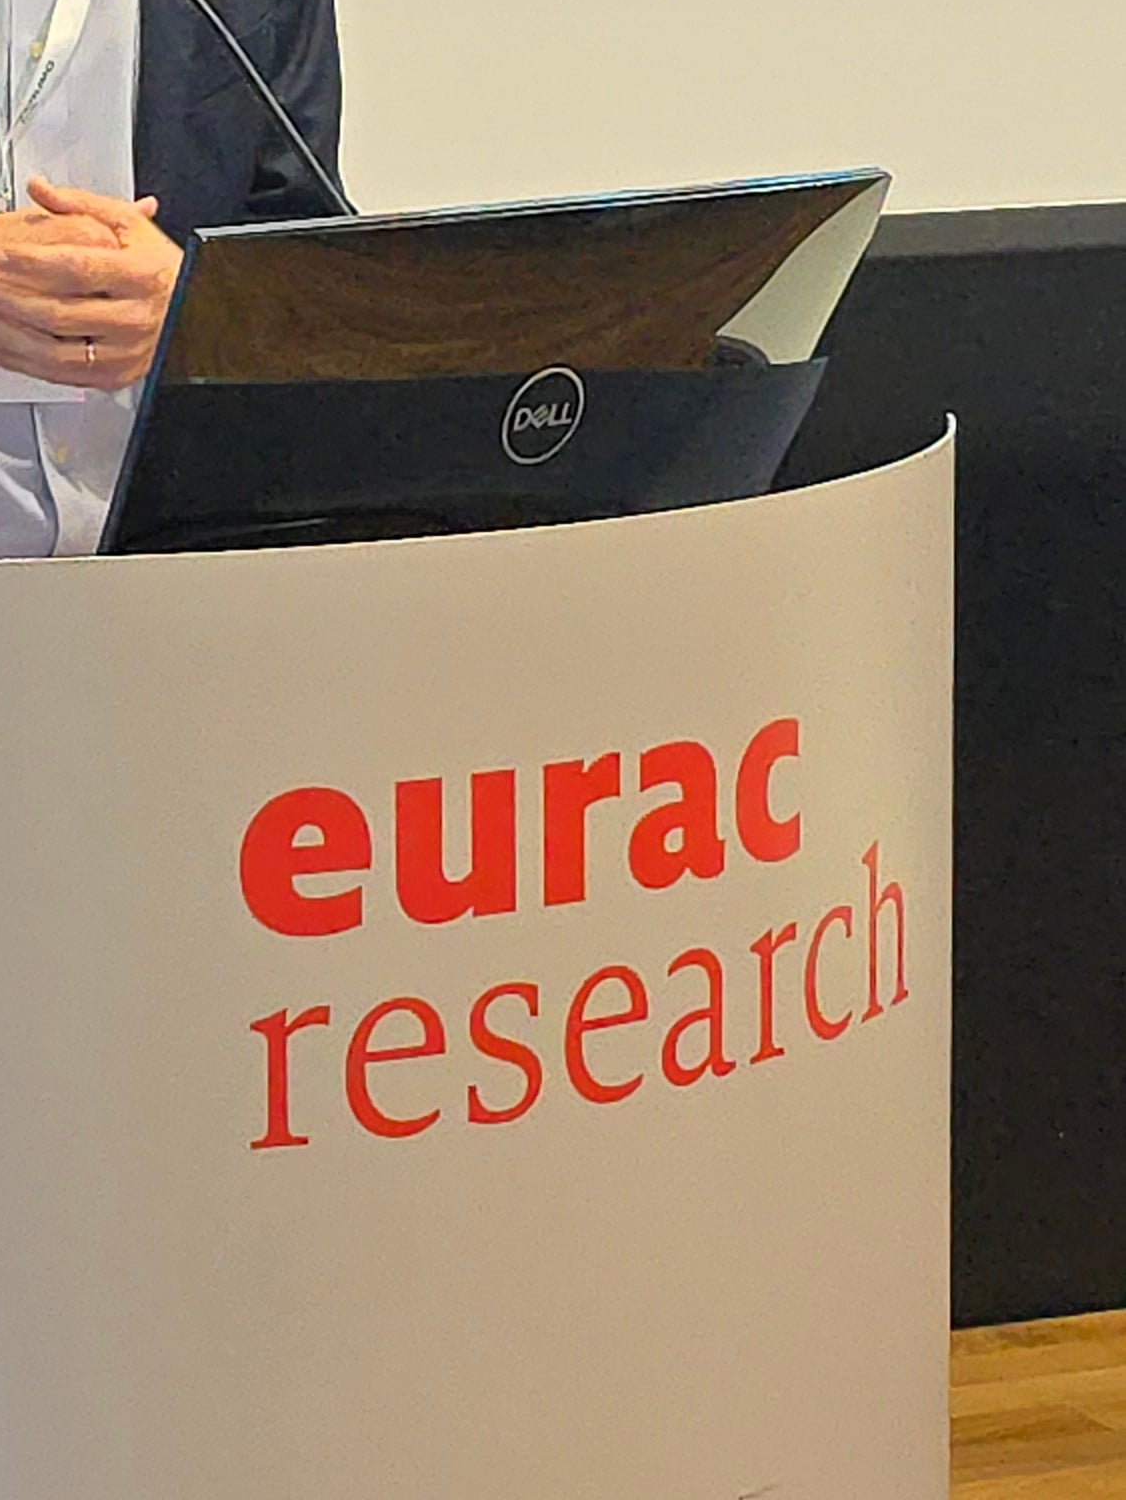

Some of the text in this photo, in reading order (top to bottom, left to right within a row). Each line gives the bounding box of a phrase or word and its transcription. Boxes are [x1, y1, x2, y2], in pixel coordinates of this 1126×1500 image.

[513, 402, 573, 431] DELL
[239, 718, 800, 937] eurac
[250, 840, 909, 1150] research
